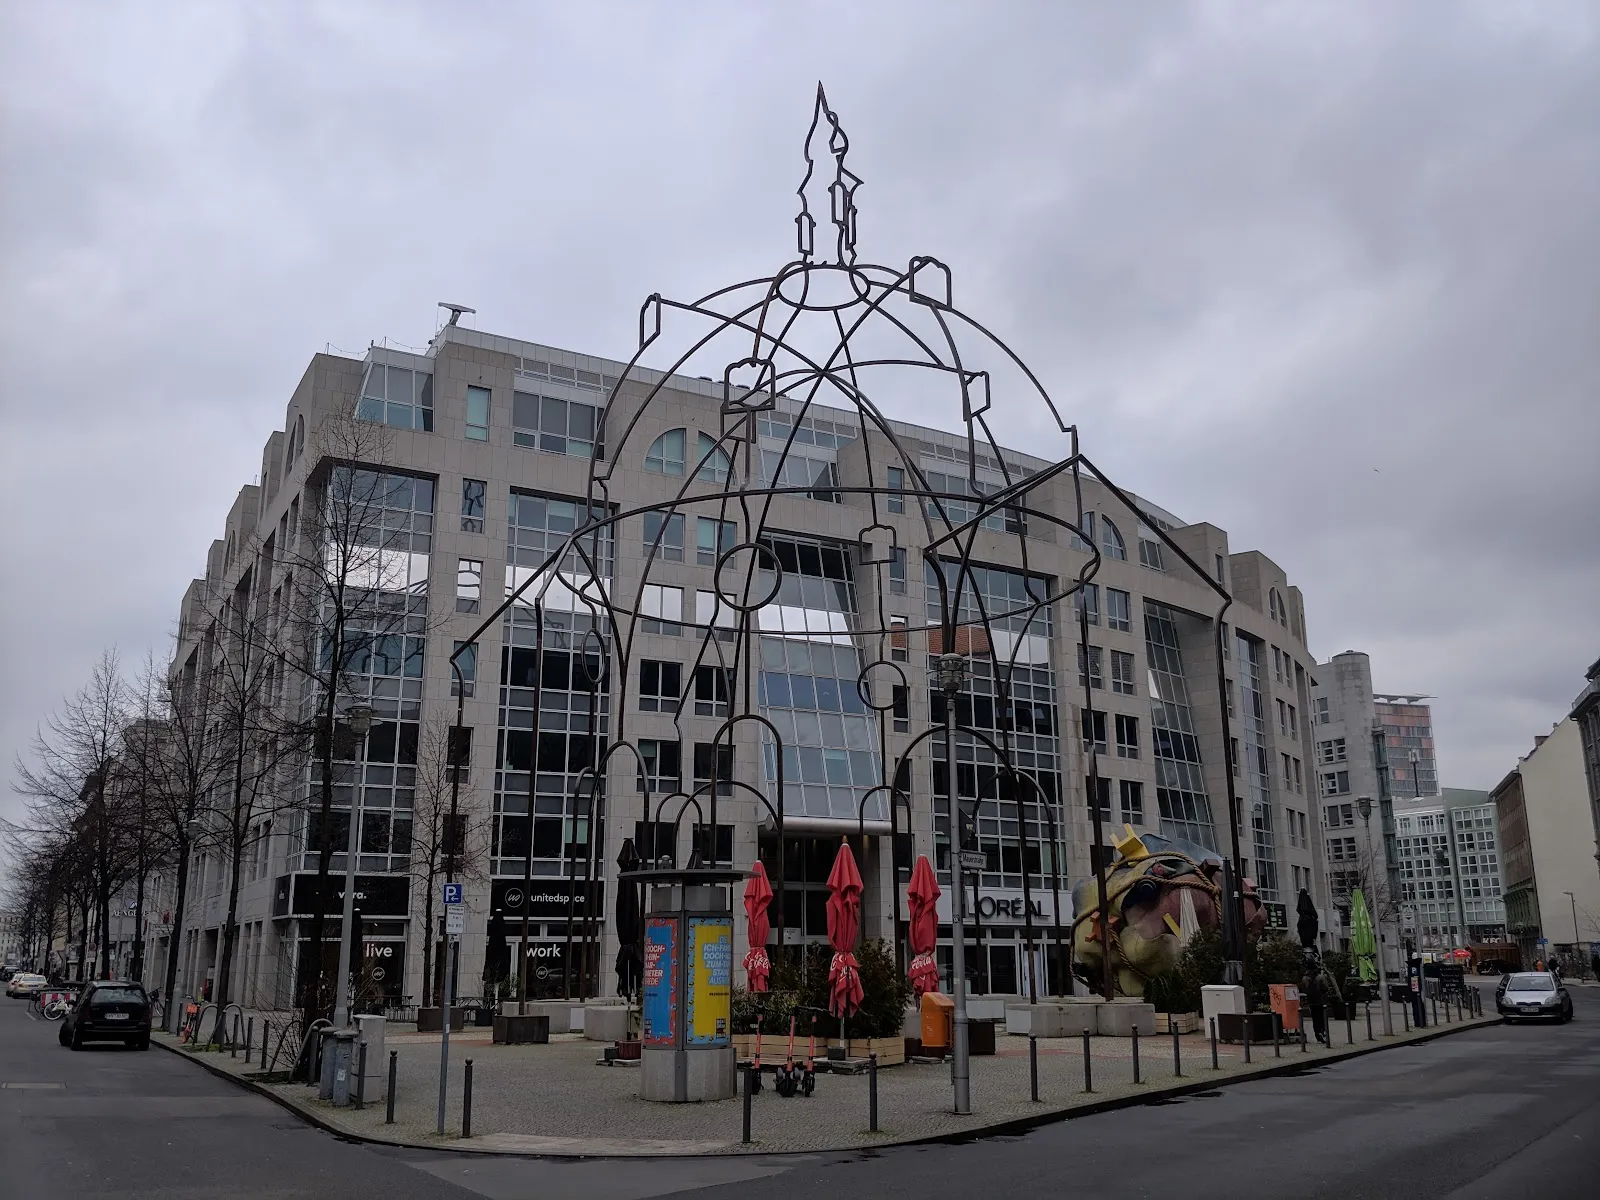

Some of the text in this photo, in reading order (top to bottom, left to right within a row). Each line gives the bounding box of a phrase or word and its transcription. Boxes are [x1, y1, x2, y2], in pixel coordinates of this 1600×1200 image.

[338, 891, 367, 899] vra.
[445, 886, 457, 902] P
[530, 892, 586, 905] unitedspce
[365, 943, 393, 958] live
[526, 943, 561, 958] work
